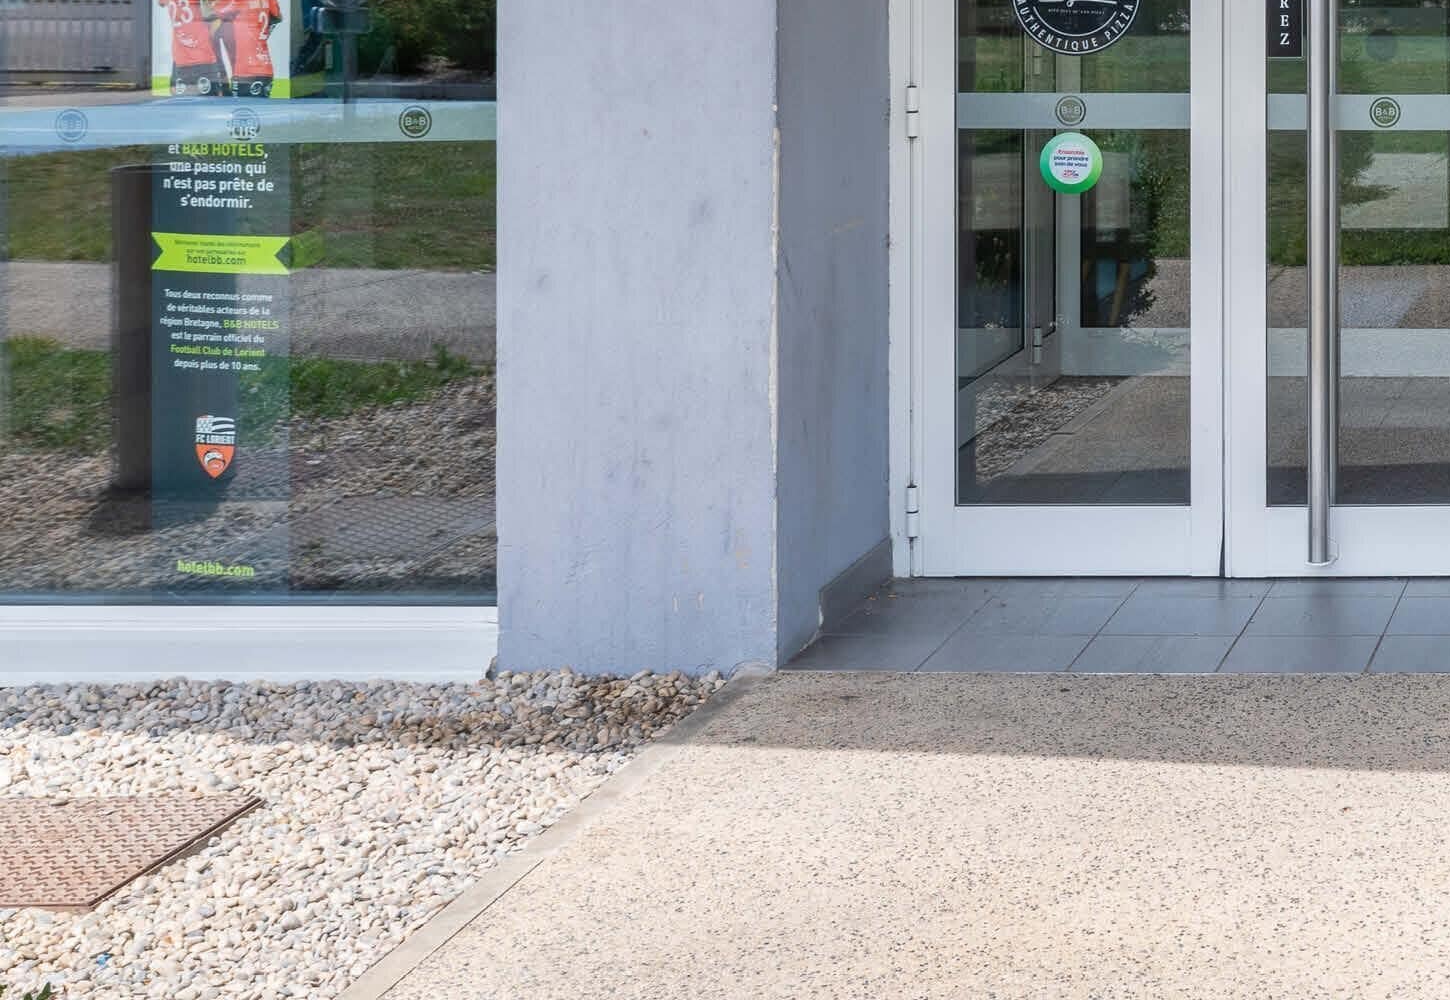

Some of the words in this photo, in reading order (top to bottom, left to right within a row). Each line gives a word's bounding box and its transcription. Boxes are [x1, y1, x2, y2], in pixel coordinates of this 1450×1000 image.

[1017, 0, 1098, 51] AUTHENTIQUE
[1104, 4, 1134, 40] PIZZA
[168, 144, 180, 154] et
[182, 144, 208, 156] B&B
[212, 144, 268, 158] HOTELS,
[169, 162, 192, 172] une
[194, 161, 242, 174] passion
[245, 162, 266, 176] qui
[163, 176, 192, 188] n'est
[194, 180, 216, 192] pas
[219, 177, 254, 193] prête
[257, 179, 274, 192] de
[180, 194, 254, 208] s'endormir.
[187, 255, 247, 265] hotelbb.com
[163, 288, 181, 298] Tous
[182, 290, 202, 299] deux
[202, 292, 240, 300] reconnus
[241, 294, 272, 302] comme
[166, 303, 176, 312] de
[249, 306, 260, 315] de
[262, 307, 270, 315] la
[160, 316, 183, 328] région
[223, 320, 242, 328] B&B
[243, 320, 280, 328] HOTELS
[170, 332, 183, 340] est
[184, 332, 192, 340] le
[192, 332, 222, 342] parrain
[223, 334, 252, 343] officiel
[253, 334, 264, 343] du
[170, 344, 202, 354] Football
[202, 346, 220, 356] Club
[222, 346, 232, 356] de
[234, 348, 265, 356] Lorient
[174, 359, 199, 368] depuis
[200, 360, 218, 370] plus
[219, 361, 230, 369] de
[232, 362, 242, 370] 10
[196, 434, 206, 443] FC
[176, 560, 255, 577] hotelbb.com
